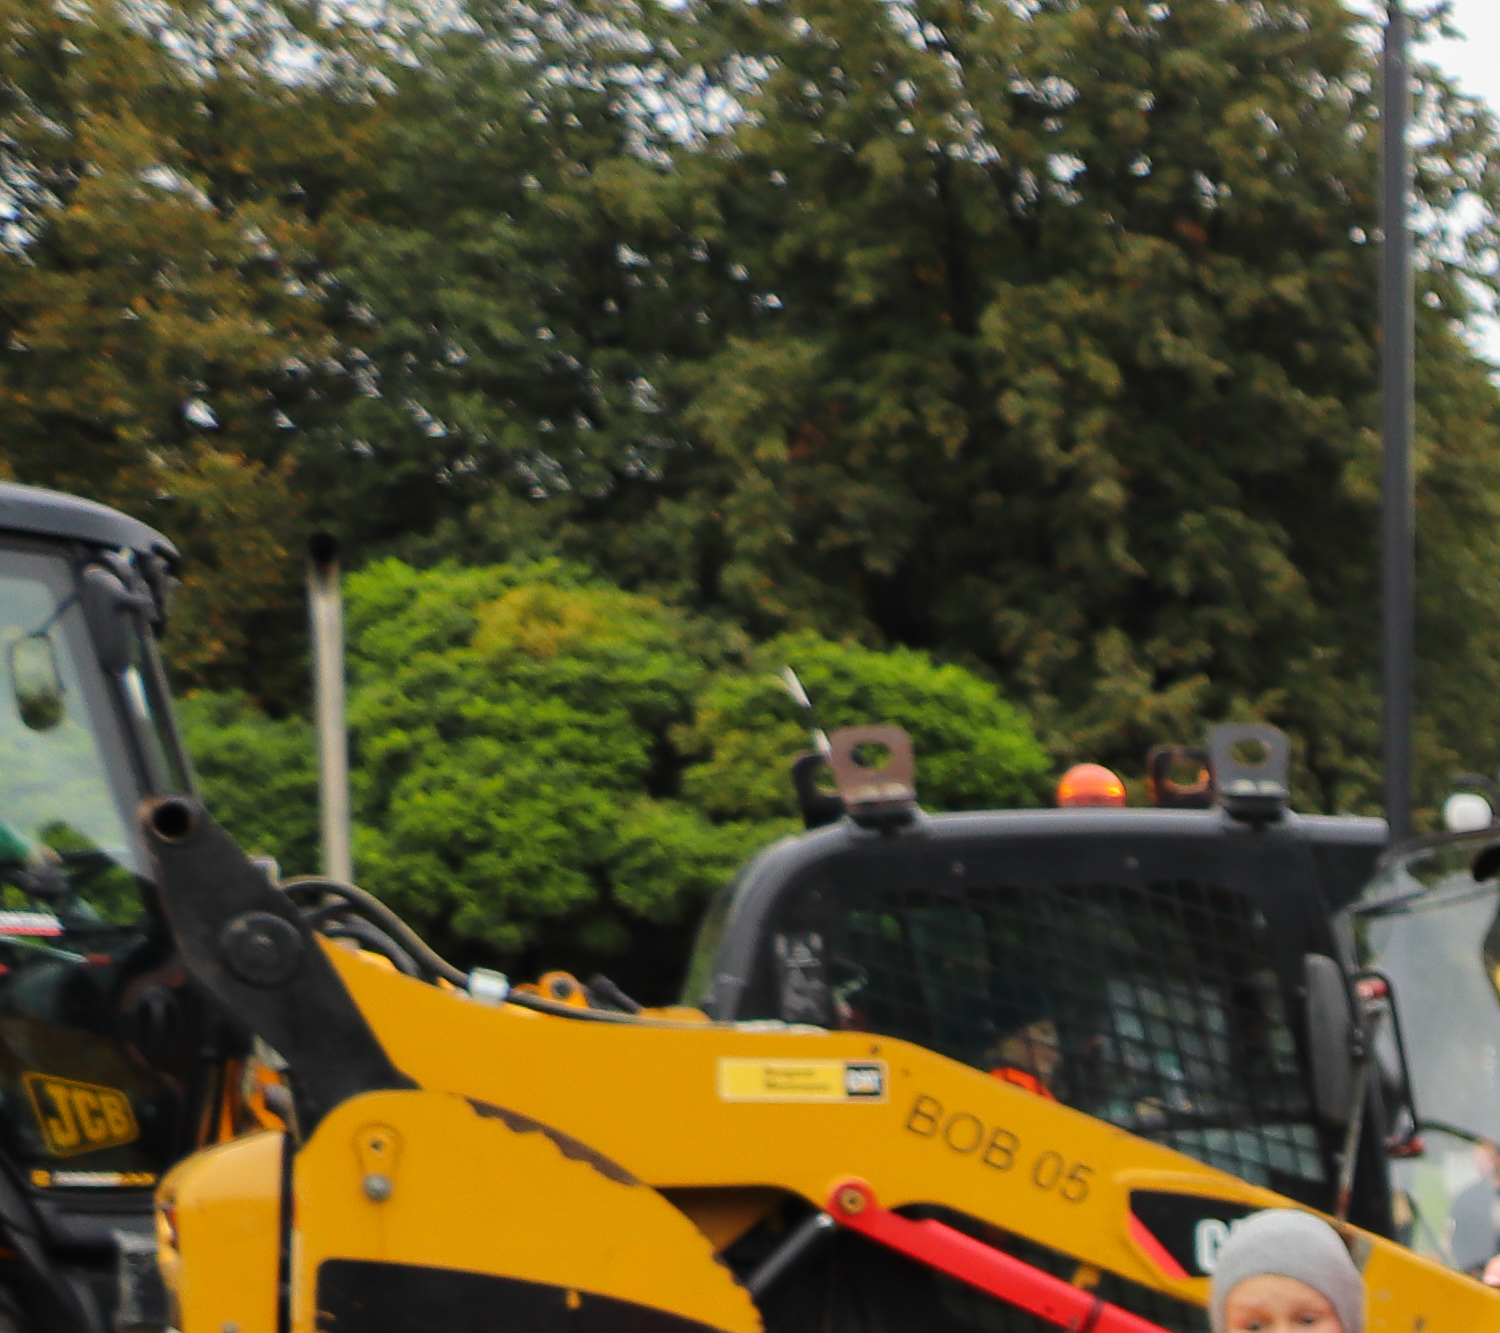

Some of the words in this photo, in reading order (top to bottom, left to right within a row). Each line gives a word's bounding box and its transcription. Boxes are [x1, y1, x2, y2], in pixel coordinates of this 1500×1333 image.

[45, 1081, 131, 1148] JCB
[905, 1095, 1021, 1172] BOB
[1032, 1150, 1097, 1203] 05
